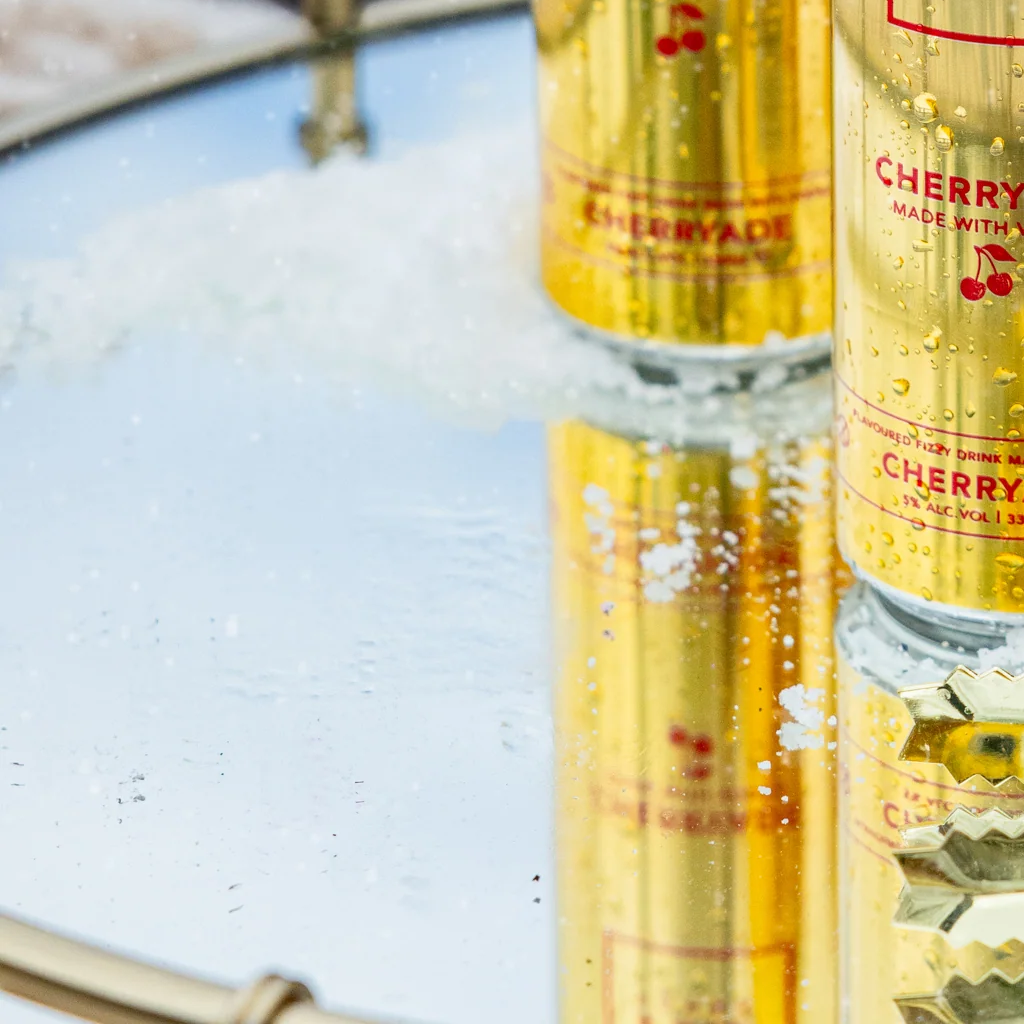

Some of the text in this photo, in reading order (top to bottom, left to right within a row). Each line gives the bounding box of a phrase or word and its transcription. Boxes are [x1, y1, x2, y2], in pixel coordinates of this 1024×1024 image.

[893, 199, 946, 228] MADE
[953, 216, 1009, 236] WITH
[853, 408, 912, 446] FLAVOURED
[915, 439, 952, 457] FIZZY
[956, 449, 1002, 465] DRINK
[903, 494, 921, 509] 5%
